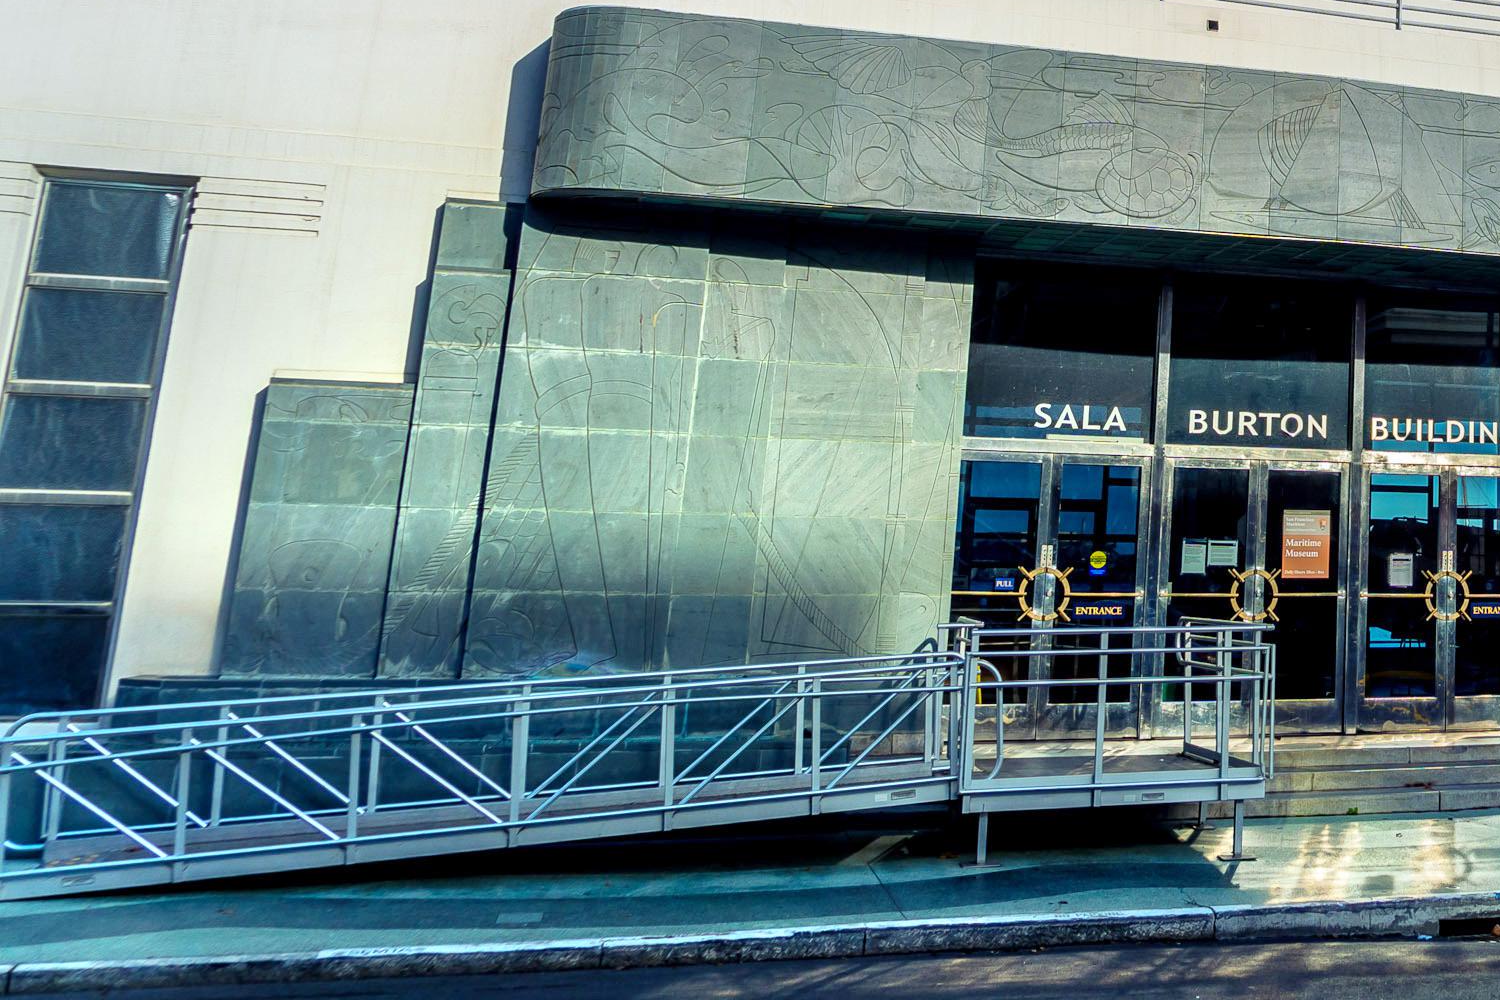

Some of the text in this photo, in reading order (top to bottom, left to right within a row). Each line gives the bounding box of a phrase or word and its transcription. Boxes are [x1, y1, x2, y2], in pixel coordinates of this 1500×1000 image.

[1033, 403, 1127, 432] SALA
[1188, 409, 1328, 439] BURTON
[1285, 539, 1321, 547] Maritime
[1285, 549, 1319, 557] Museum
[1075, 607, 1122, 615] ENTRANCE
